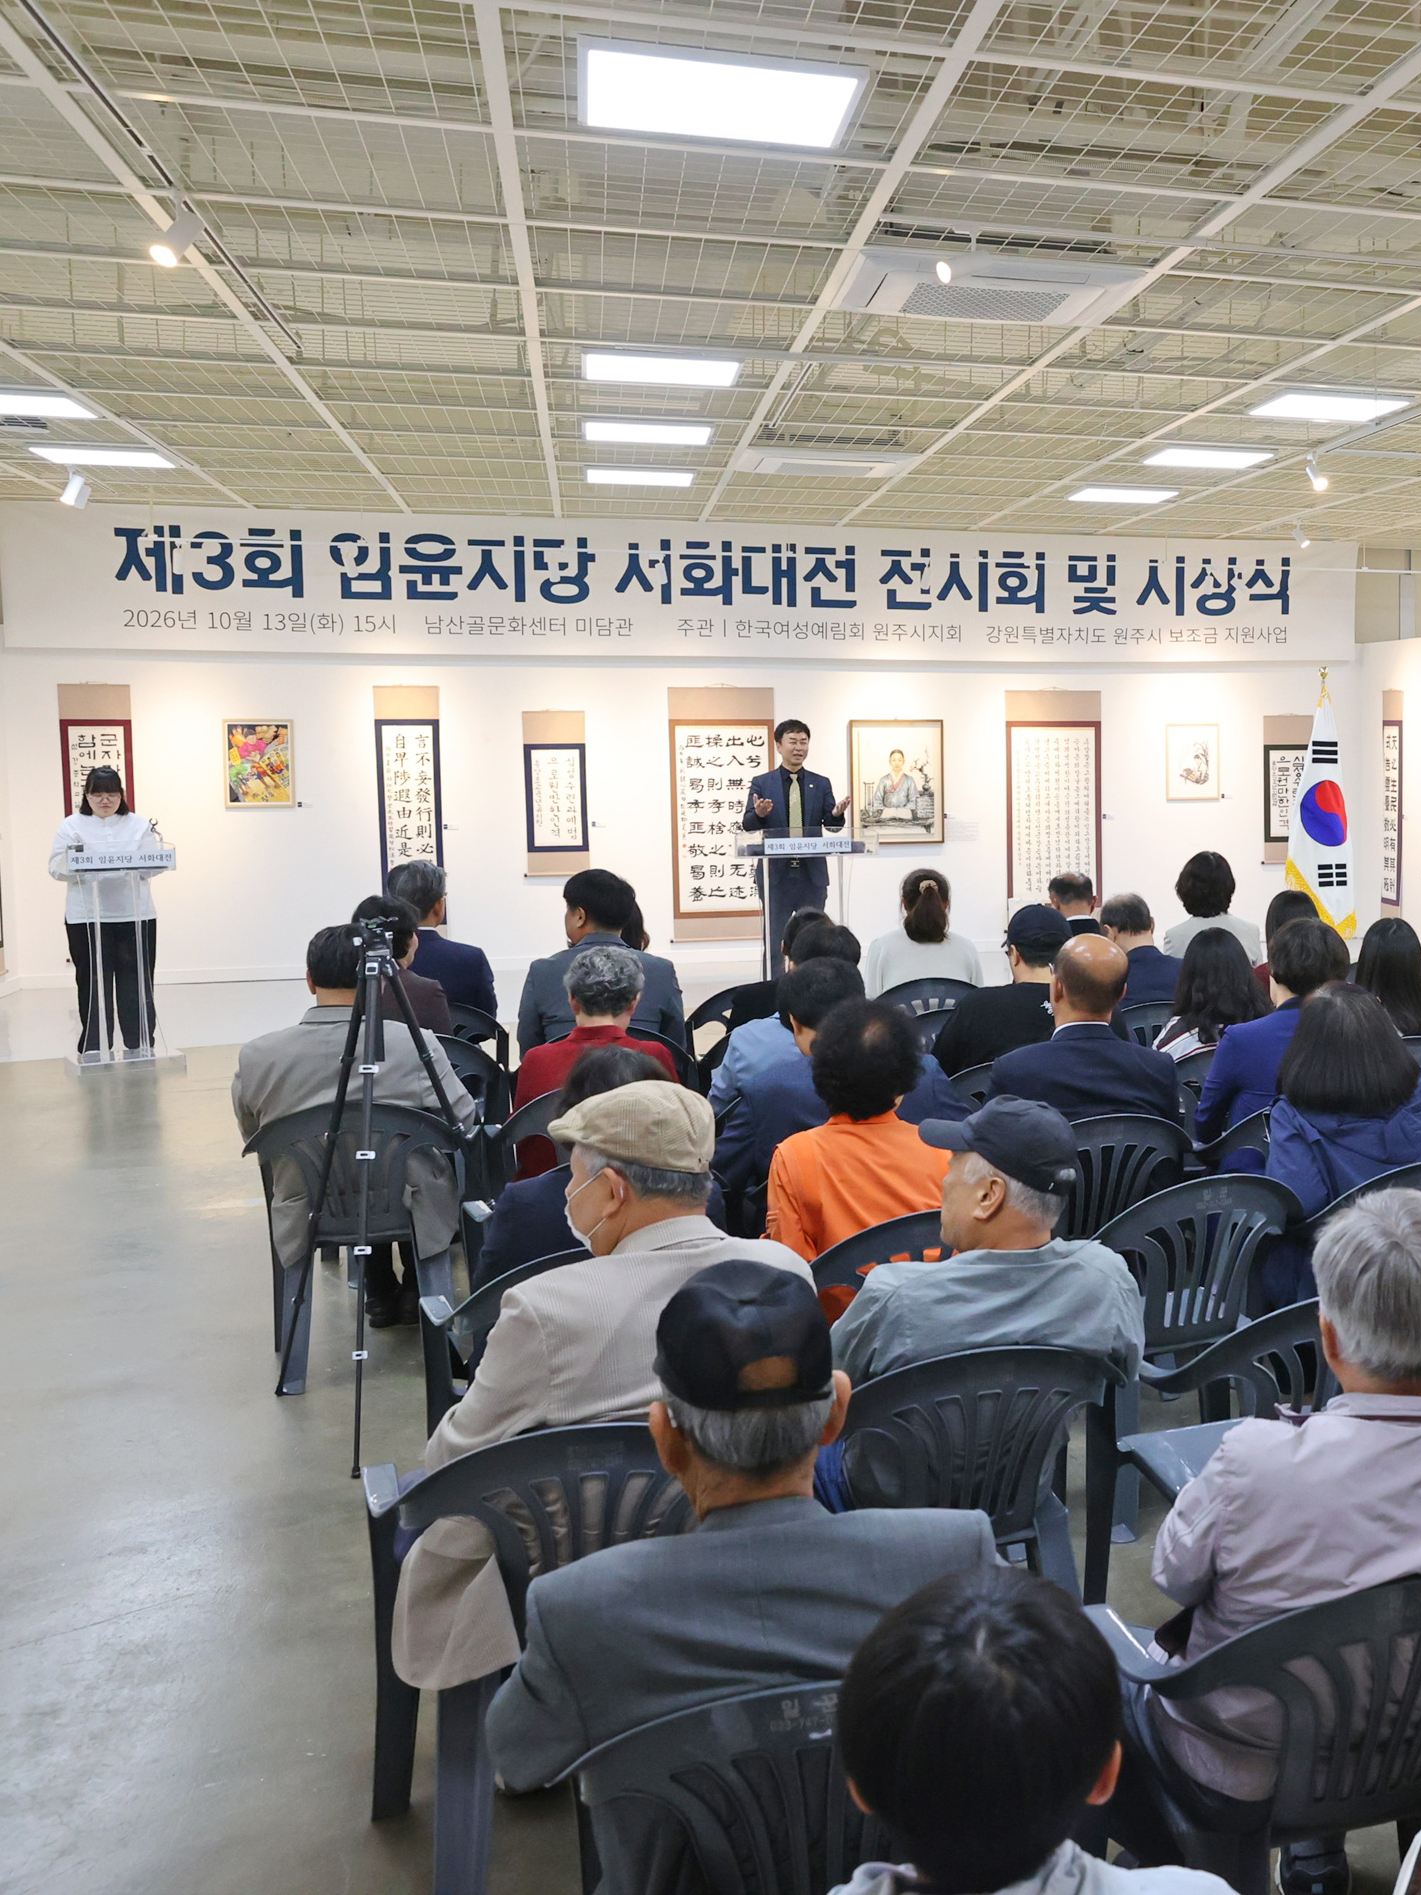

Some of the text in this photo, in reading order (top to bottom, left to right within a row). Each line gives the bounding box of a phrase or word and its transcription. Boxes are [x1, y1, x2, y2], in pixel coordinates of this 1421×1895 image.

[114, 526, 1291, 617] 제3회 임윤지당 서화대전 전시회 및 시상식
[122, 609, 198, 630] 2026년
[207, 611, 253, 632] 10월
[263, 612, 344, 636] 13일(화)
[353, 614, 397, 635] 15시
[424, 614, 567, 638] 남산골문화센터
[575, 615, 634, 639] 미담관
[677, 618, 715, 639] 주관
[735, 618, 865, 641] 한국여성예림회
[872, 620, 963, 643] 원주시지회
[986, 622, 1106, 645] 강원특별자치도
[1112, 623, 1162, 645] 원주시
[1169, 625, 1219, 645] 보조금
[1224, 625, 1287, 646] 지원사업
[415, 734, 434, 864] 言不妄發行則必
[70, 853, 172, 865] 제3회 임윤지당 서화대전
[766, 843, 785, 851] 제3회
